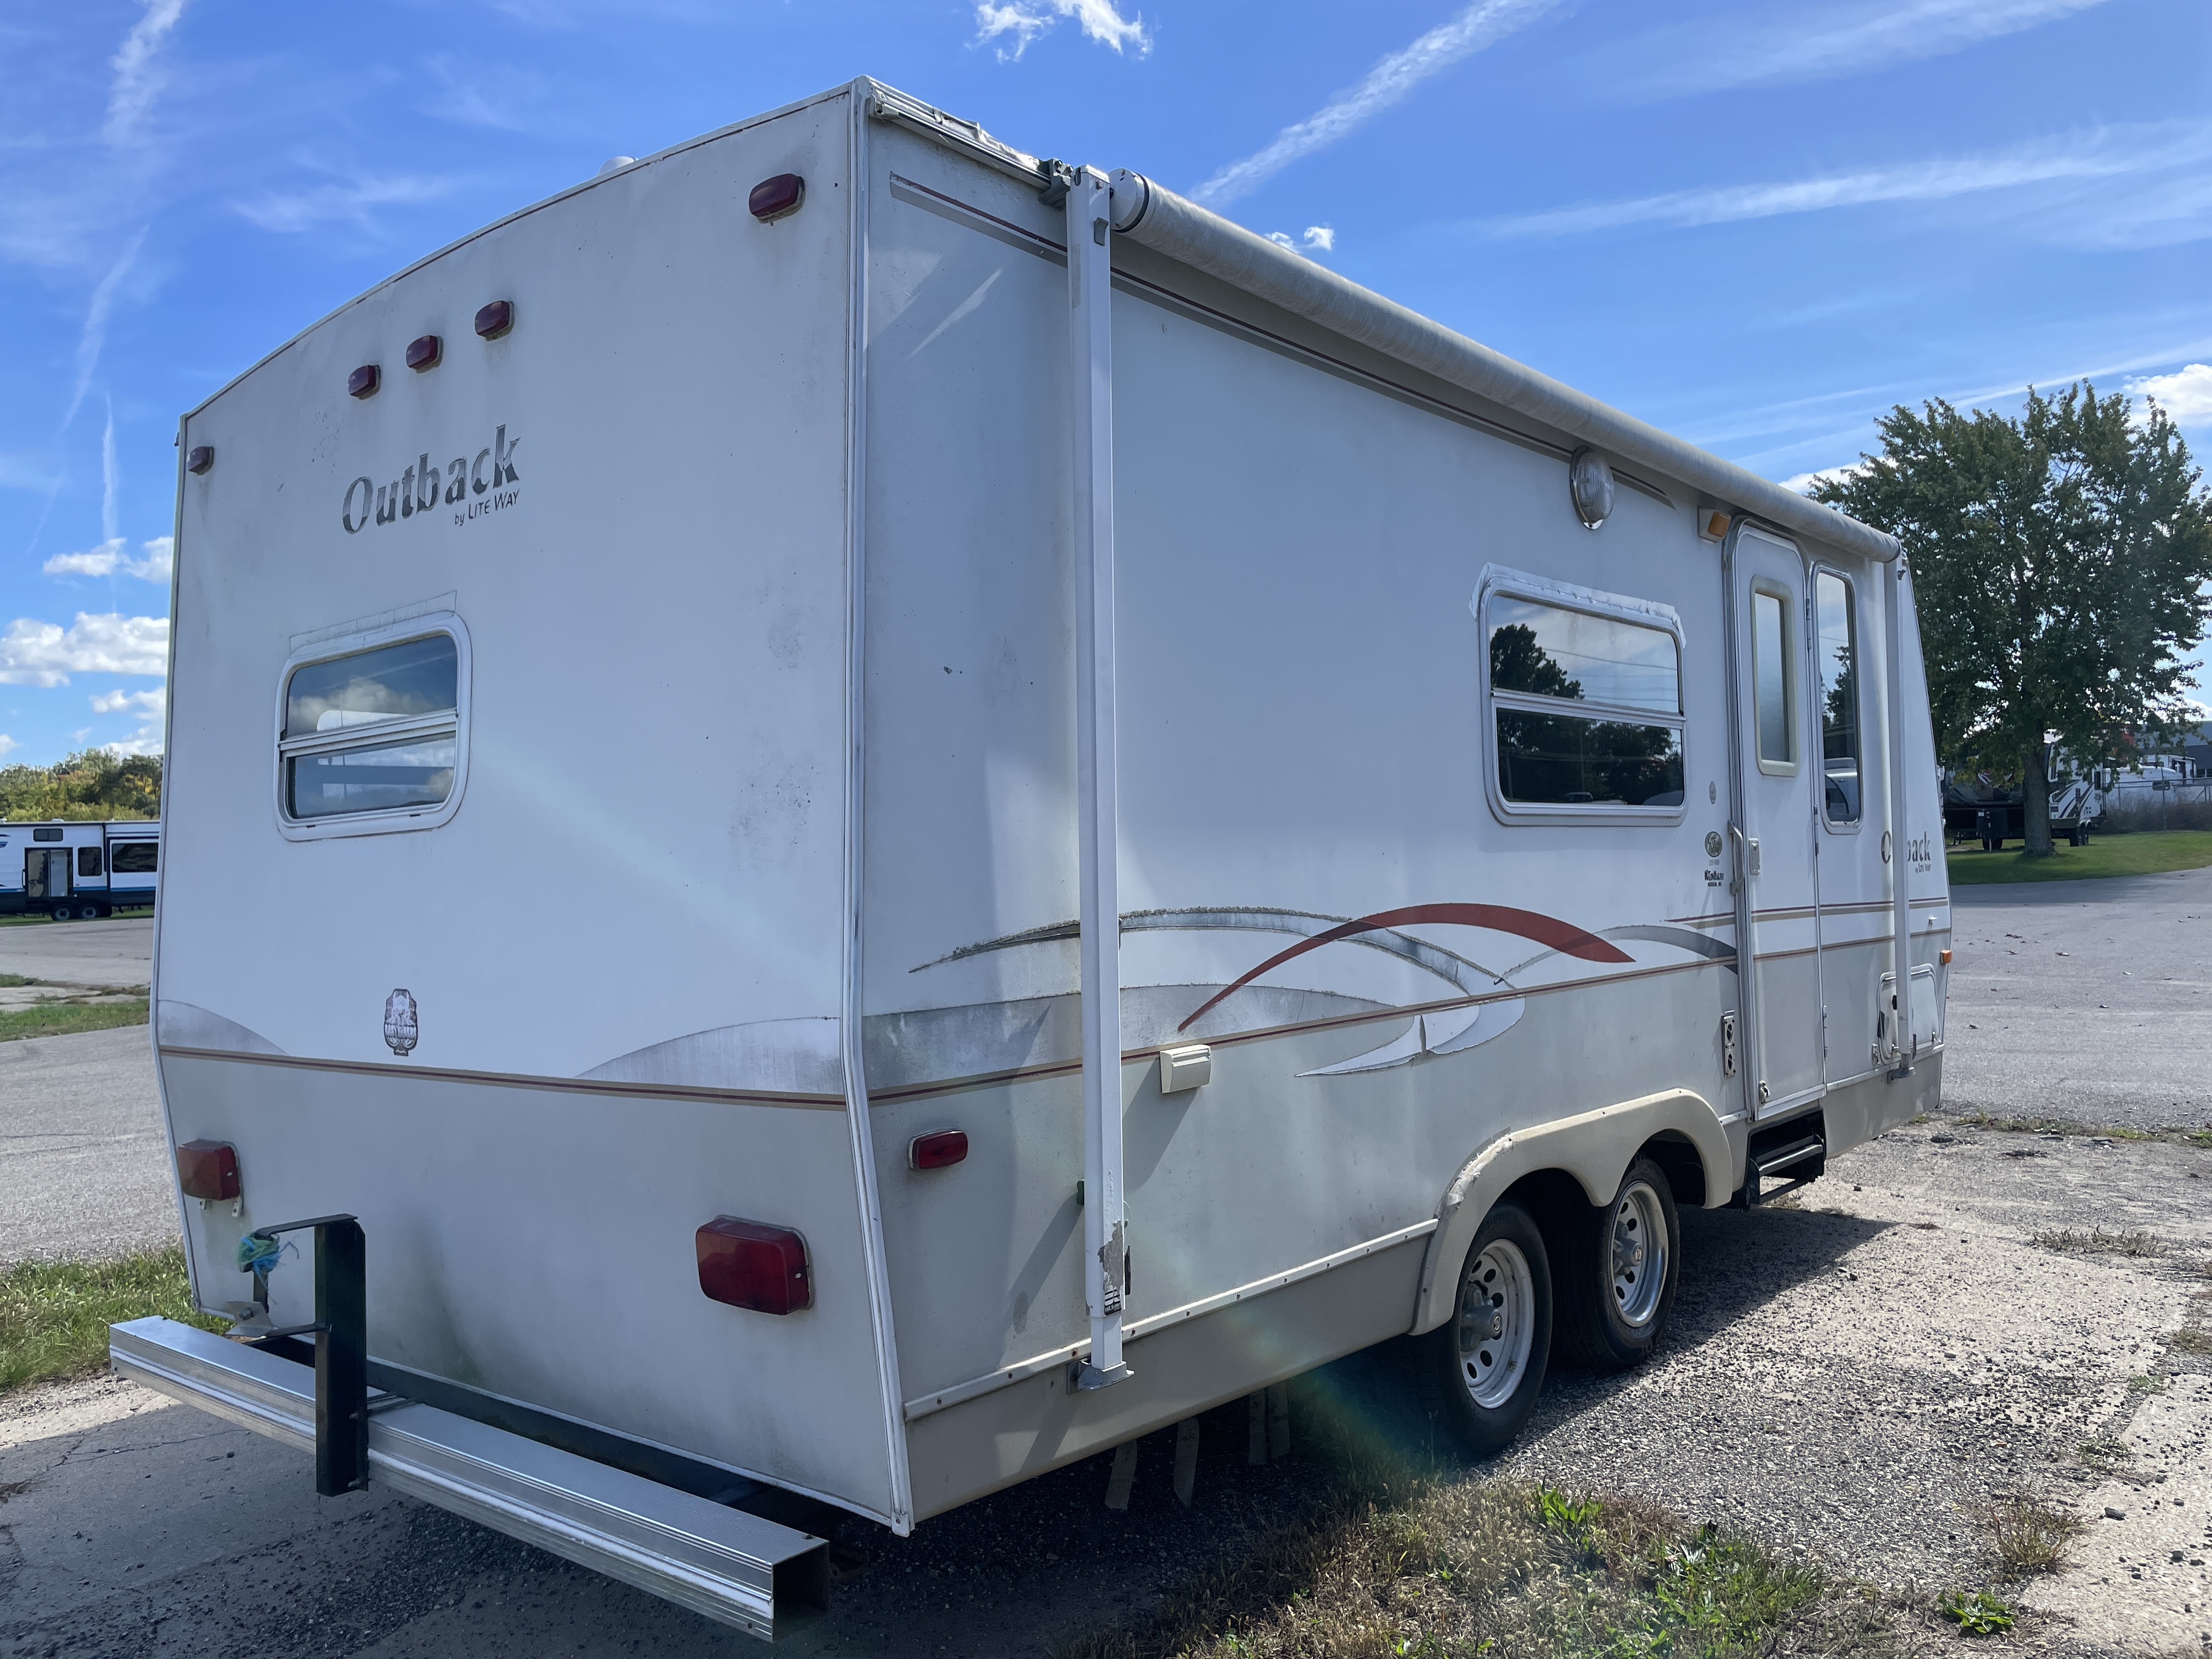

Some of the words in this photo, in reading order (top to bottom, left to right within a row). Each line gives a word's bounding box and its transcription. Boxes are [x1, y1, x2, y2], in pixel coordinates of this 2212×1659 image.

[342, 424, 521, 534] Outback
[454, 512, 465, 527] by
[468, 499, 490, 520] LITE
[494, 488, 521, 511] WAY
